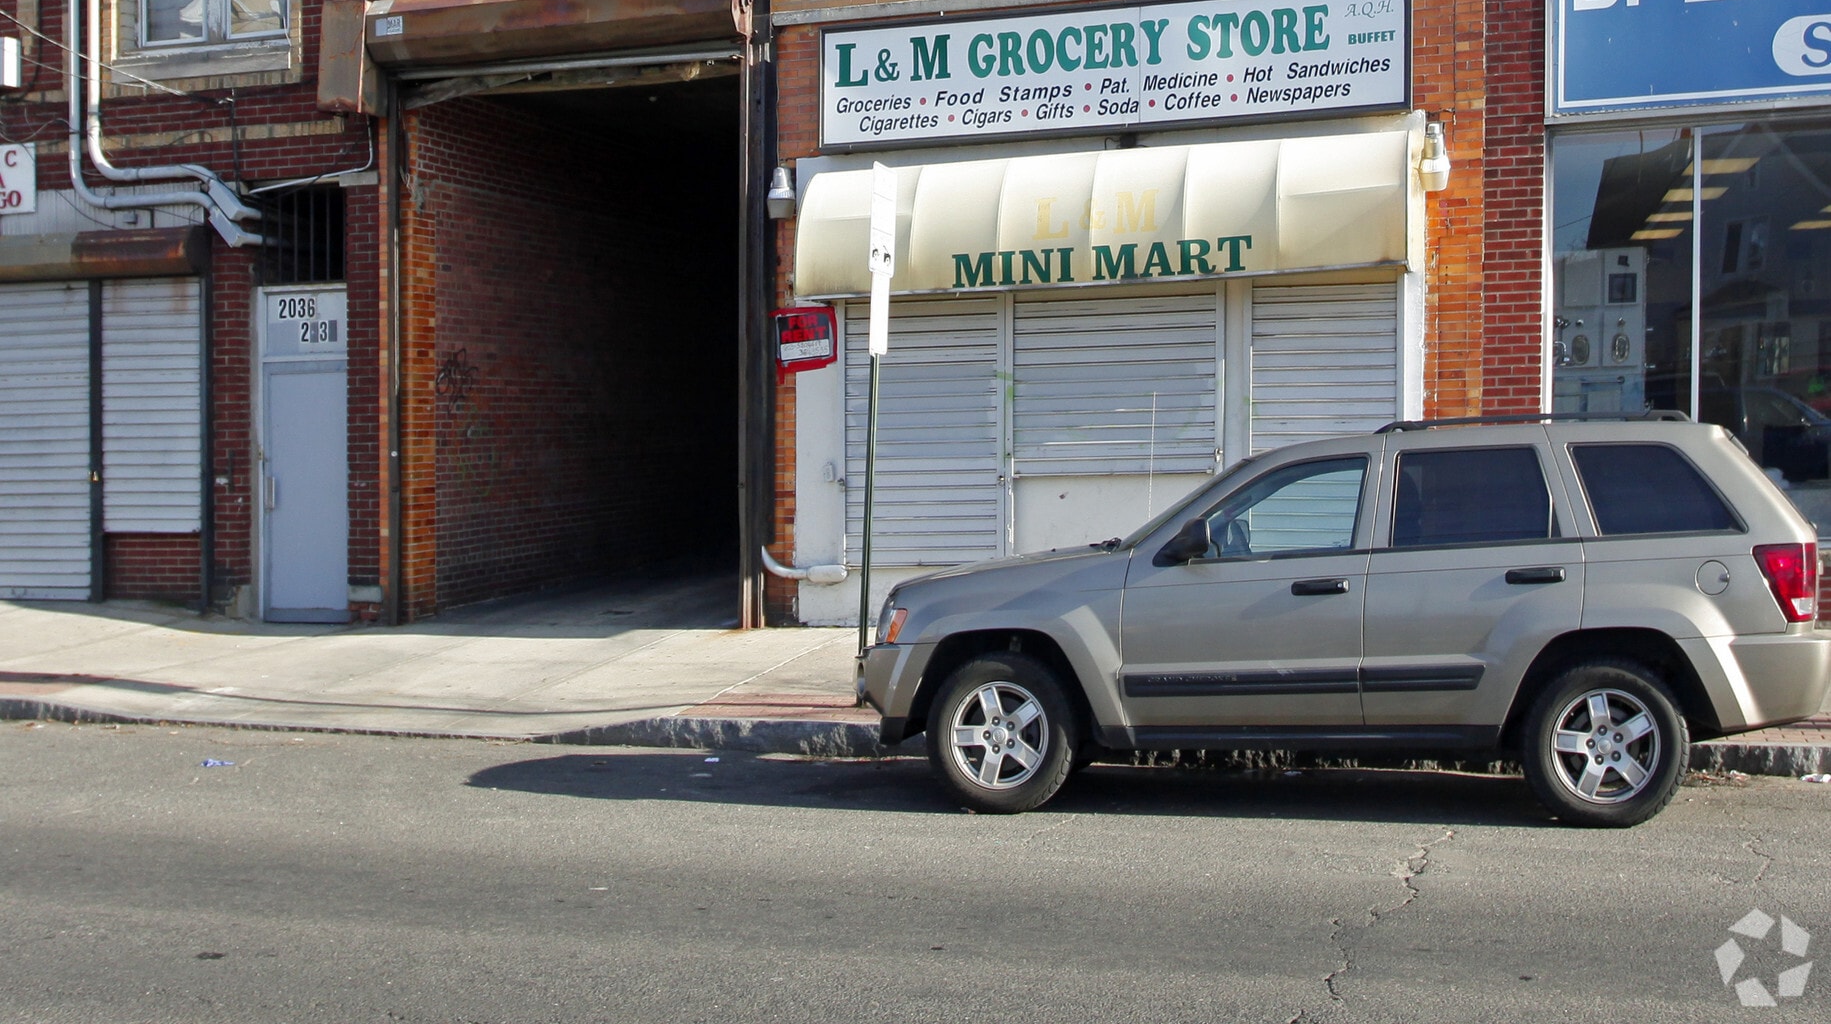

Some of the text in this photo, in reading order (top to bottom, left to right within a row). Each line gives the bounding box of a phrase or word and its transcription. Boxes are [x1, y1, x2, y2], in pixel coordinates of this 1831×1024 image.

[968, 19, 1169, 78] GROCERY
[1187, 4, 1330, 60] STORE
[1348, 30, 1396, 45] BUFFET
[836, 57, 1391, 114] Groceries Food Stamps Pat. Medicine Hot Sandwiches
[859, 82, 1351, 135] Cigarettes Cigars Gifts Soda Coffee Newspapers
[952, 235, 1252, 288] MINI MART
[279, 298, 315, 319] 2036
[788, 314, 818, 328] FOR
[781, 326, 826, 344] RENT
